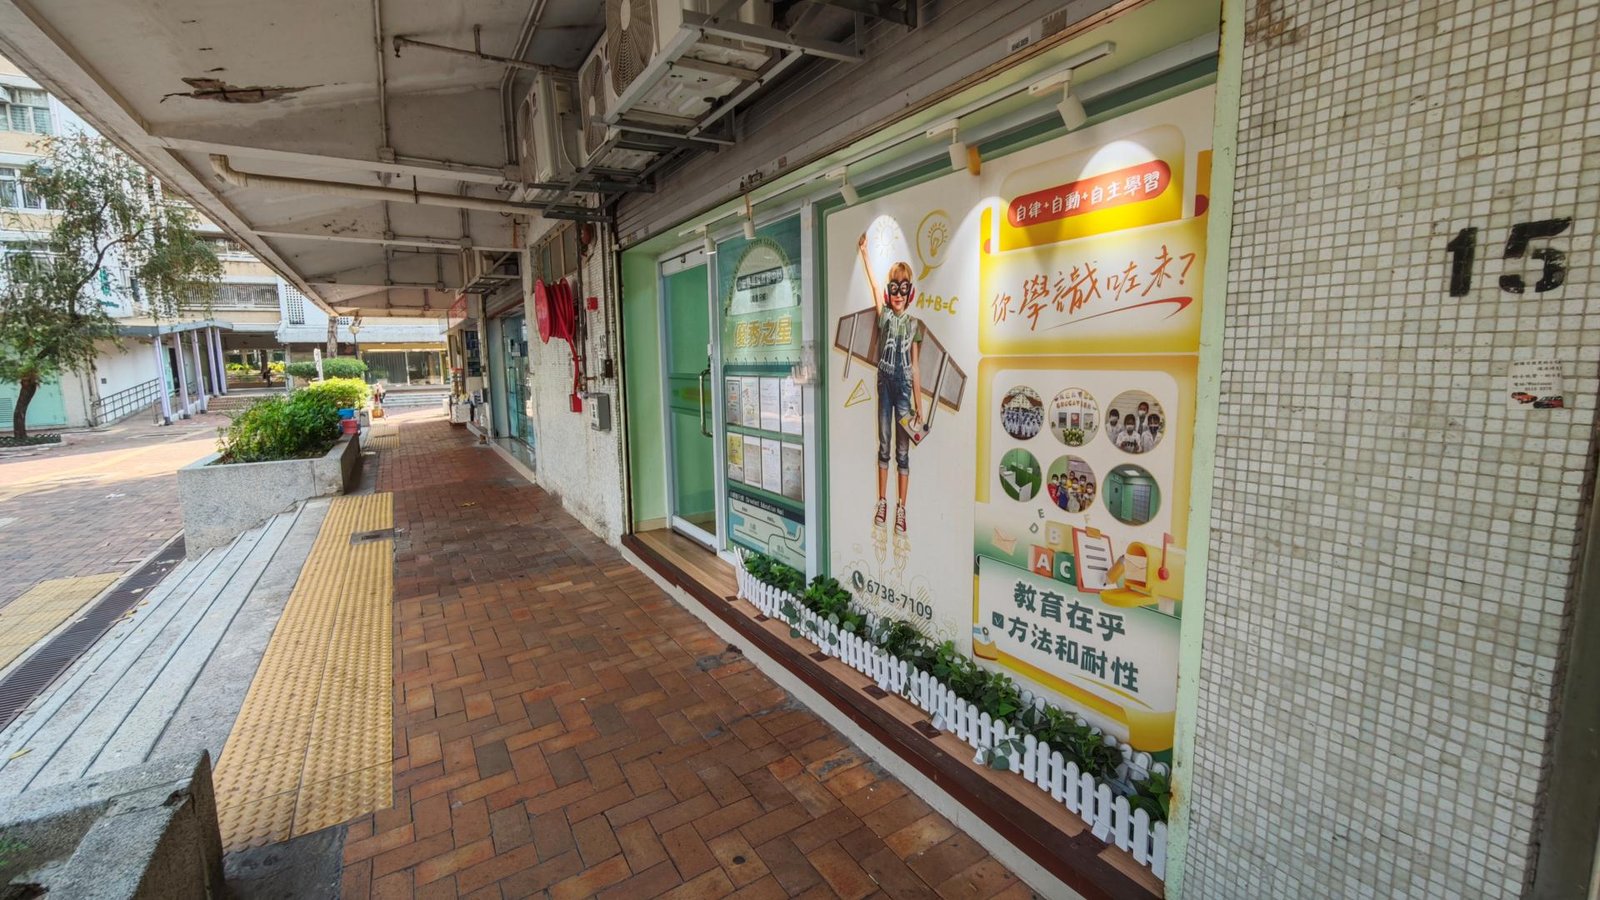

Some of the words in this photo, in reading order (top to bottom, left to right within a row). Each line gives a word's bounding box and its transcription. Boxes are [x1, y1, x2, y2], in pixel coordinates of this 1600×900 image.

[1447, 217, 1572, 297] 15
[916, 292, 960, 315] A+B=C
[1037, 553, 1051, 572] A
[1059, 561, 1071, 579] C
[867, 579, 933, 620] 6738-7109
[1014, 580, 1126, 642] 教育在乎
[1007, 616, 1139, 693] 方法和耐性
